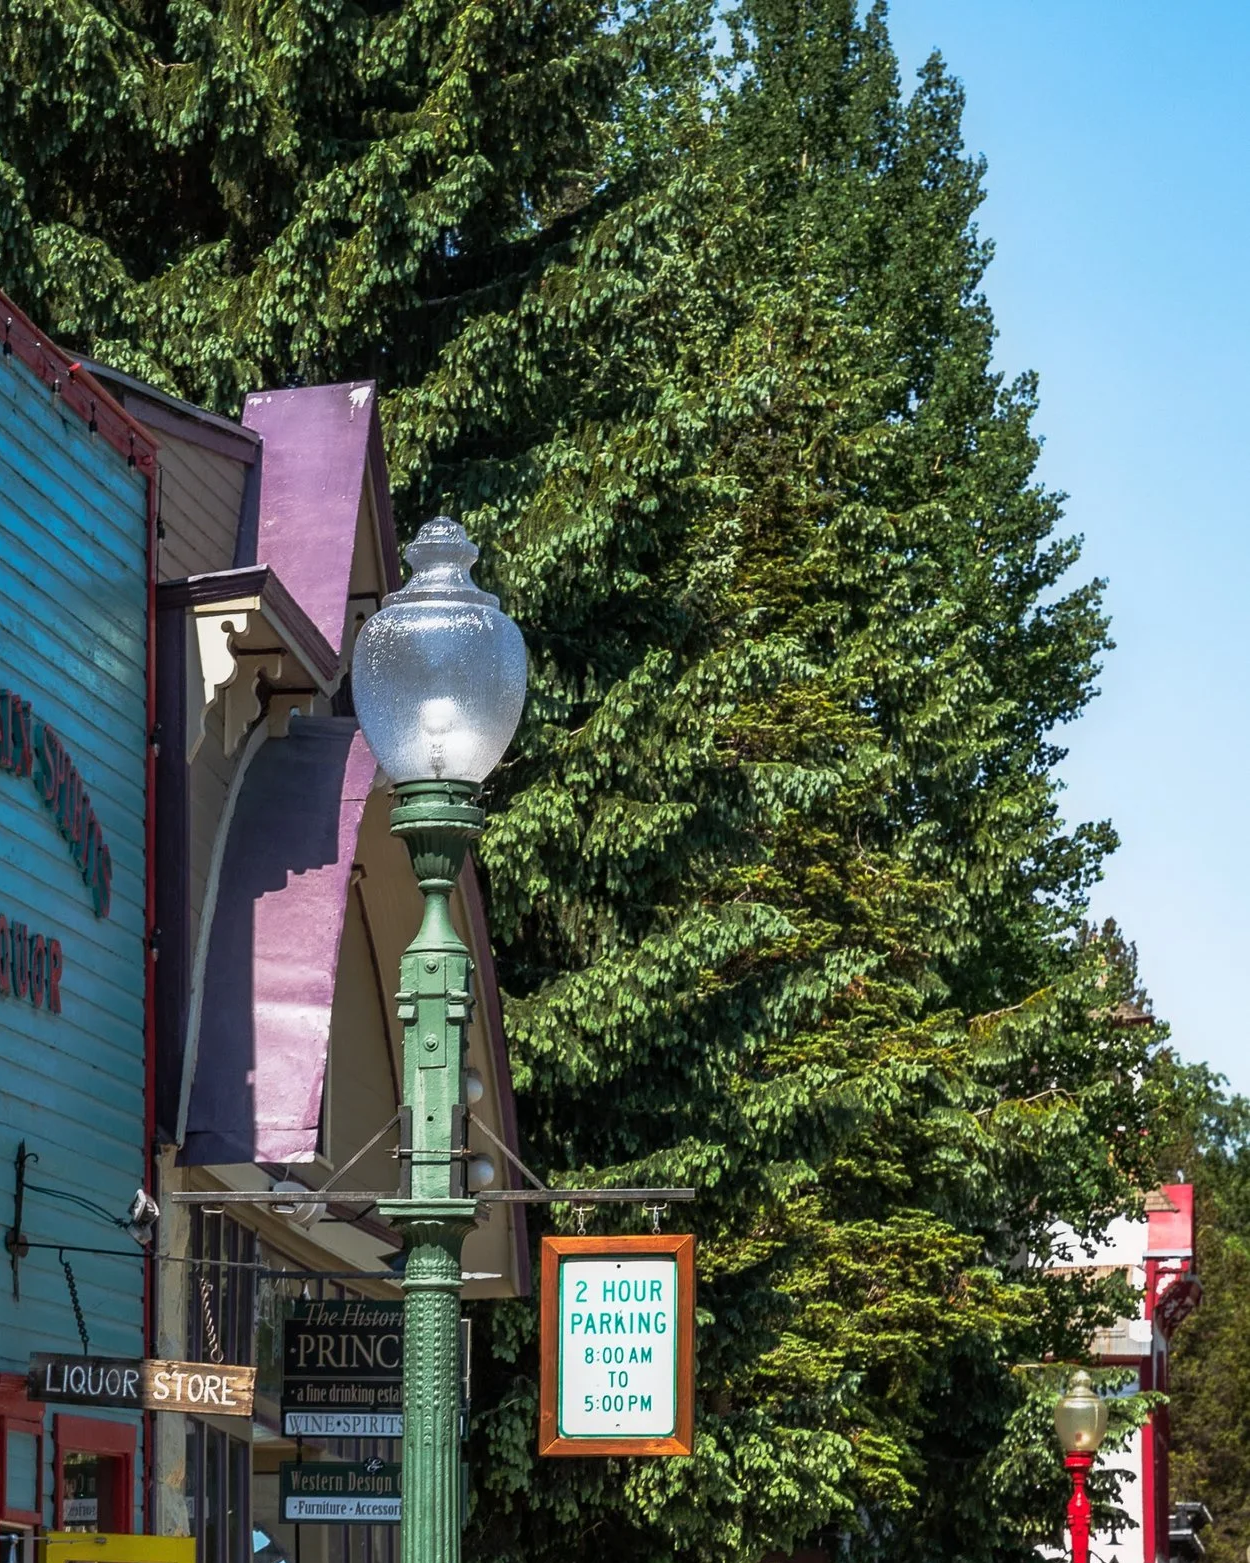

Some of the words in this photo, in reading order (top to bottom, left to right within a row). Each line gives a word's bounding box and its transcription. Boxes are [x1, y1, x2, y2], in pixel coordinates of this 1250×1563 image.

[575, 1280, 588, 1303] 2
[602, 1280, 663, 1303] HOUR
[305, 1302, 338, 1327] The
[340, 1303, 405, 1328] Histori
[570, 1311, 667, 1335] PARKING
[296, 1334, 404, 1370] PRINC
[584, 1346, 625, 1365] 8:00
[628, 1346, 653, 1364] AM
[45, 1363, 140, 1400] LIQUOR
[153, 1369, 239, 1407] STORE
[608, 1370, 629, 1388] TO
[297, 1387, 304, 1402] a
[306, 1384, 327, 1402] fine
[329, 1383, 375, 1406] drinking
[584, 1394, 624, 1412] 5:00
[628, 1394, 652, 1412] PM
[291, 1470, 343, 1492] Western
[348, 1471, 393, 1496] Design
[298, 1501, 347, 1516] Furniture
